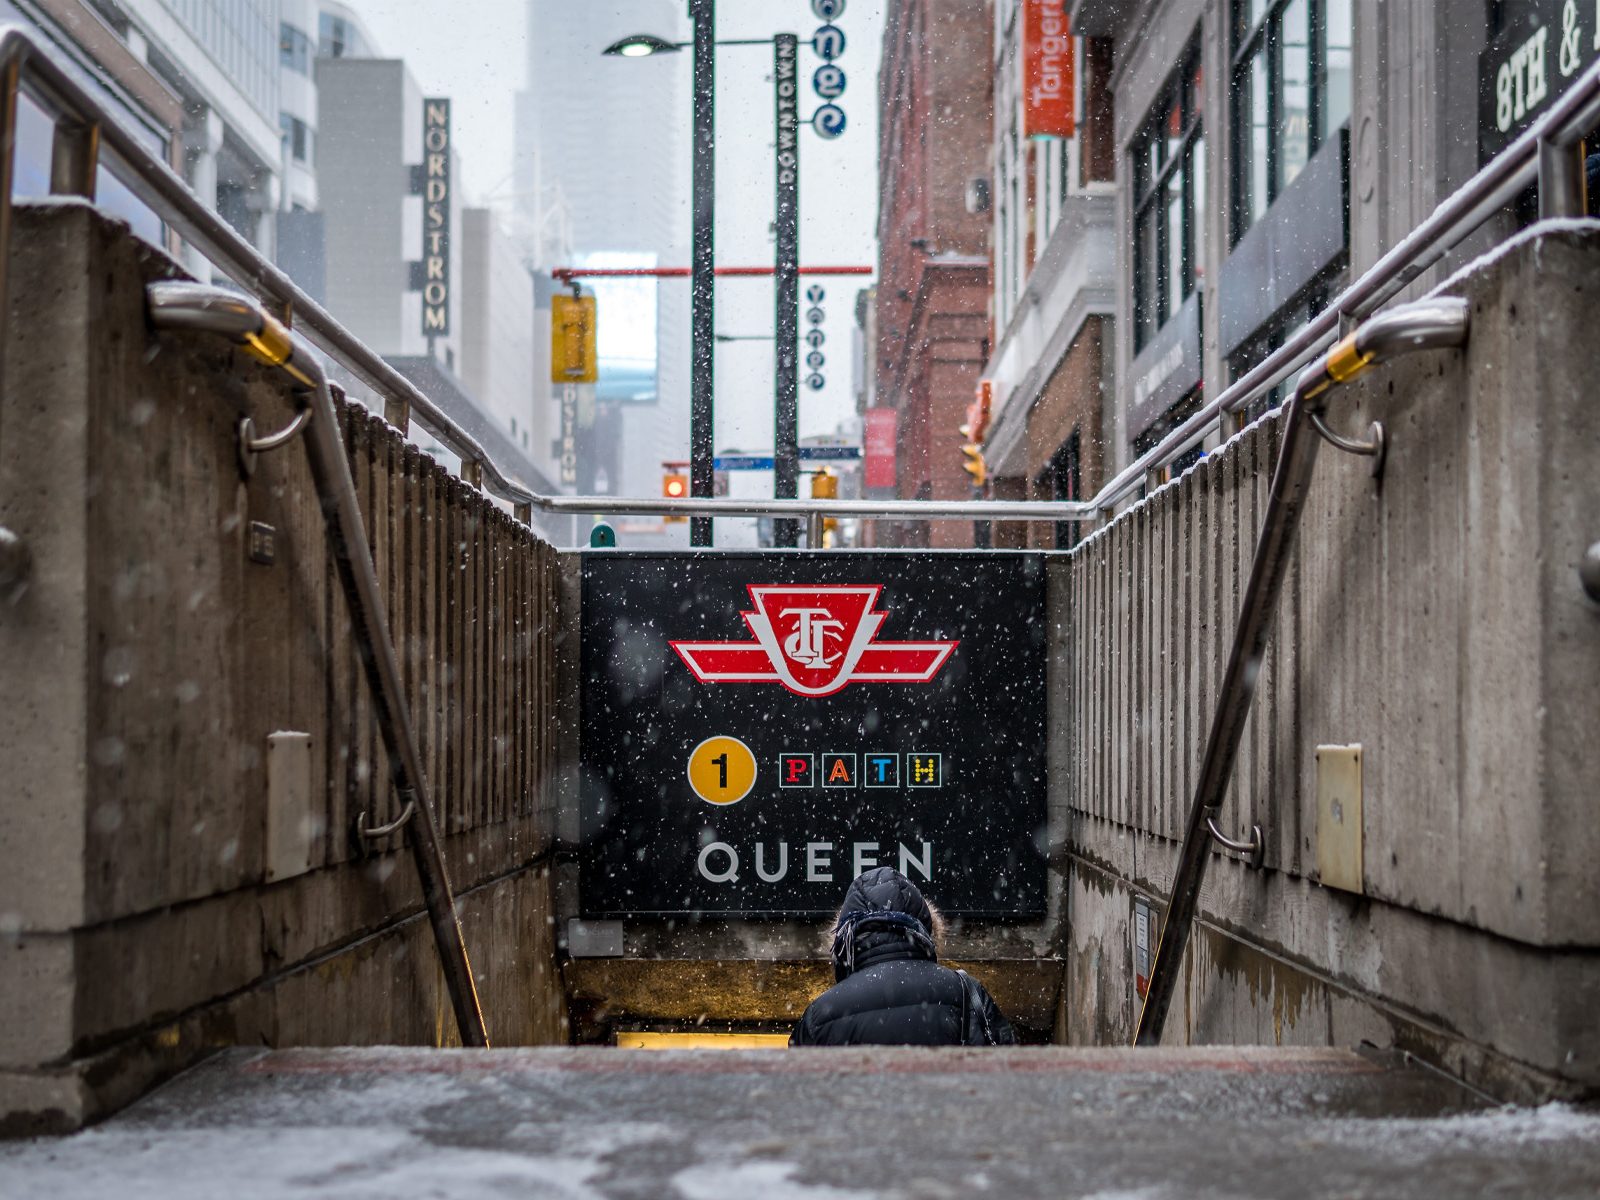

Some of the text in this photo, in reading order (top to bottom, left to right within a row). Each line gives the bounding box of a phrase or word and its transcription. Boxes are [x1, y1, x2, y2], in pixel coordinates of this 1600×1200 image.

[778, 43, 795, 185] DOWNTOWN
[1496, 25, 1547, 133] 8TH
[1559, 0, 1581, 77] &
[427, 105, 447, 330] NORDSTROM
[711, 753, 937, 789] 1 PATH
[697, 841, 932, 884] QUEEN
